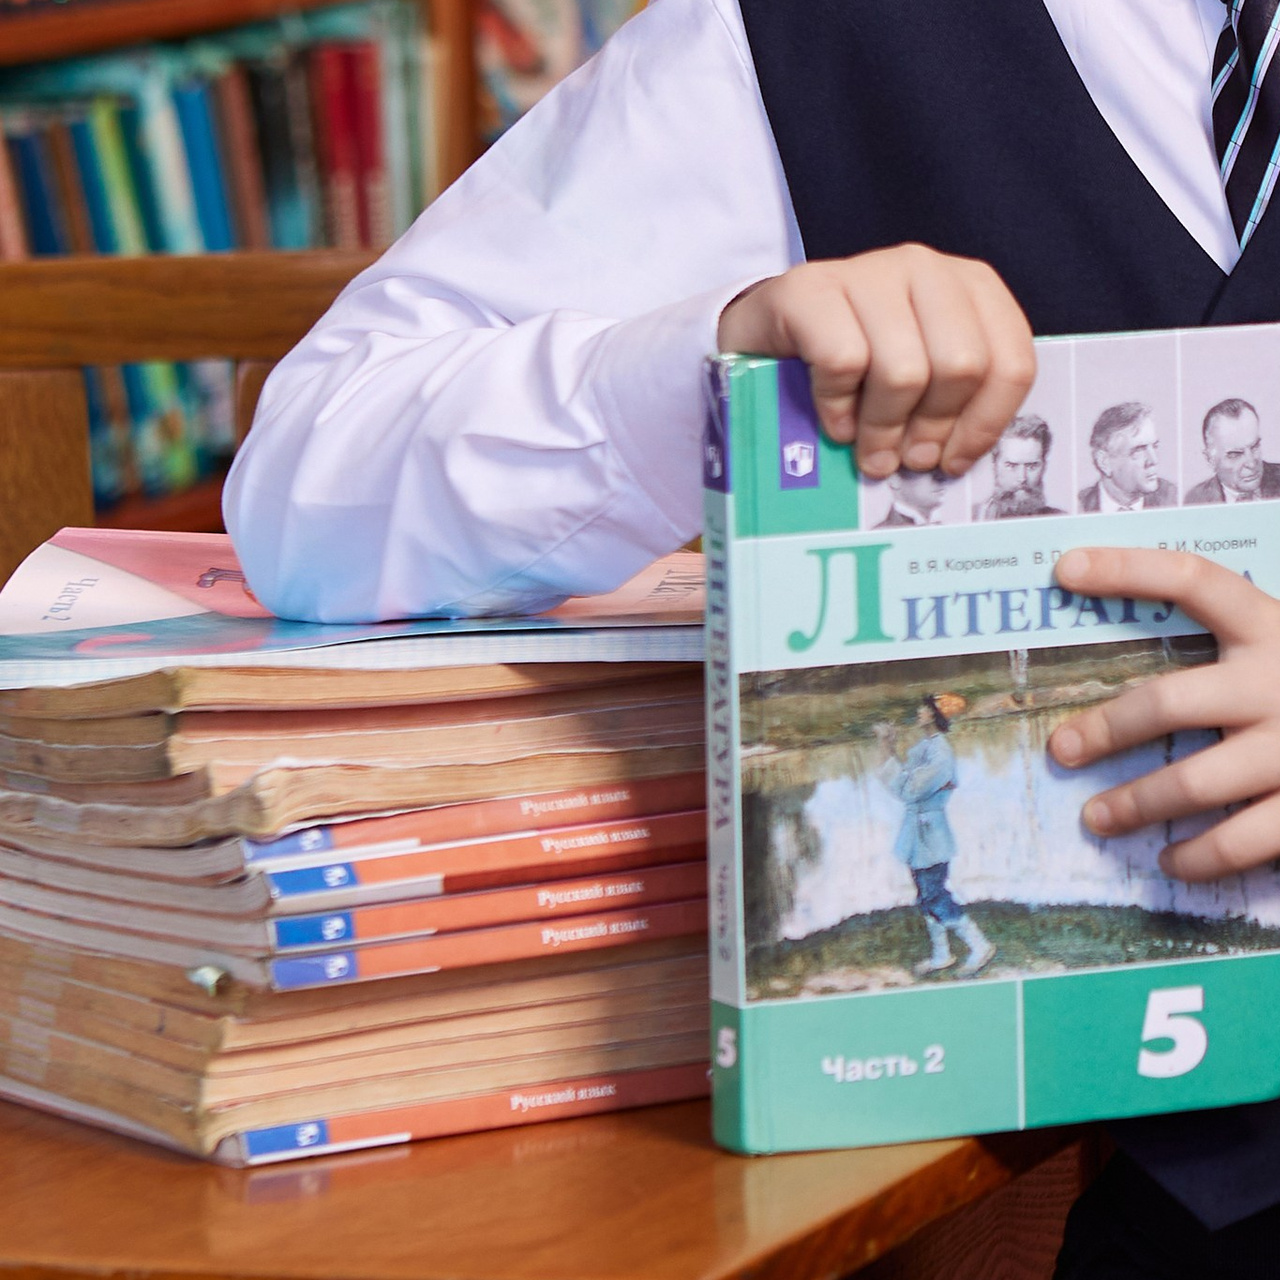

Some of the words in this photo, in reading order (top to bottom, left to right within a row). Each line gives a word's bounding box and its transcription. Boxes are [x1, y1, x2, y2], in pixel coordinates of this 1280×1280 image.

[945, 555, 1018, 573] Коровина
[1194, 538, 1257, 553] Коровин
[50, 578, 100, 616] Часть
[520, 794, 588, 817] Русский
[590, 789, 630, 805] язык
[540, 830, 609, 853] Русский
[610, 828, 651, 841] язык
[537, 883, 604, 908] Русский
[605, 881, 645, 896] язык
[541, 922, 608, 947] Русский
[609, 918, 649, 933] язык
[716, 1026, 737, 1068] 5
[1137, 984, 1209, 1078] 5
[821, 1055, 919, 1083] Часть
[923, 1043, 946, 1074] 2
[510, 1087, 576, 1113] Русский
[577, 1083, 617, 1101] язык
